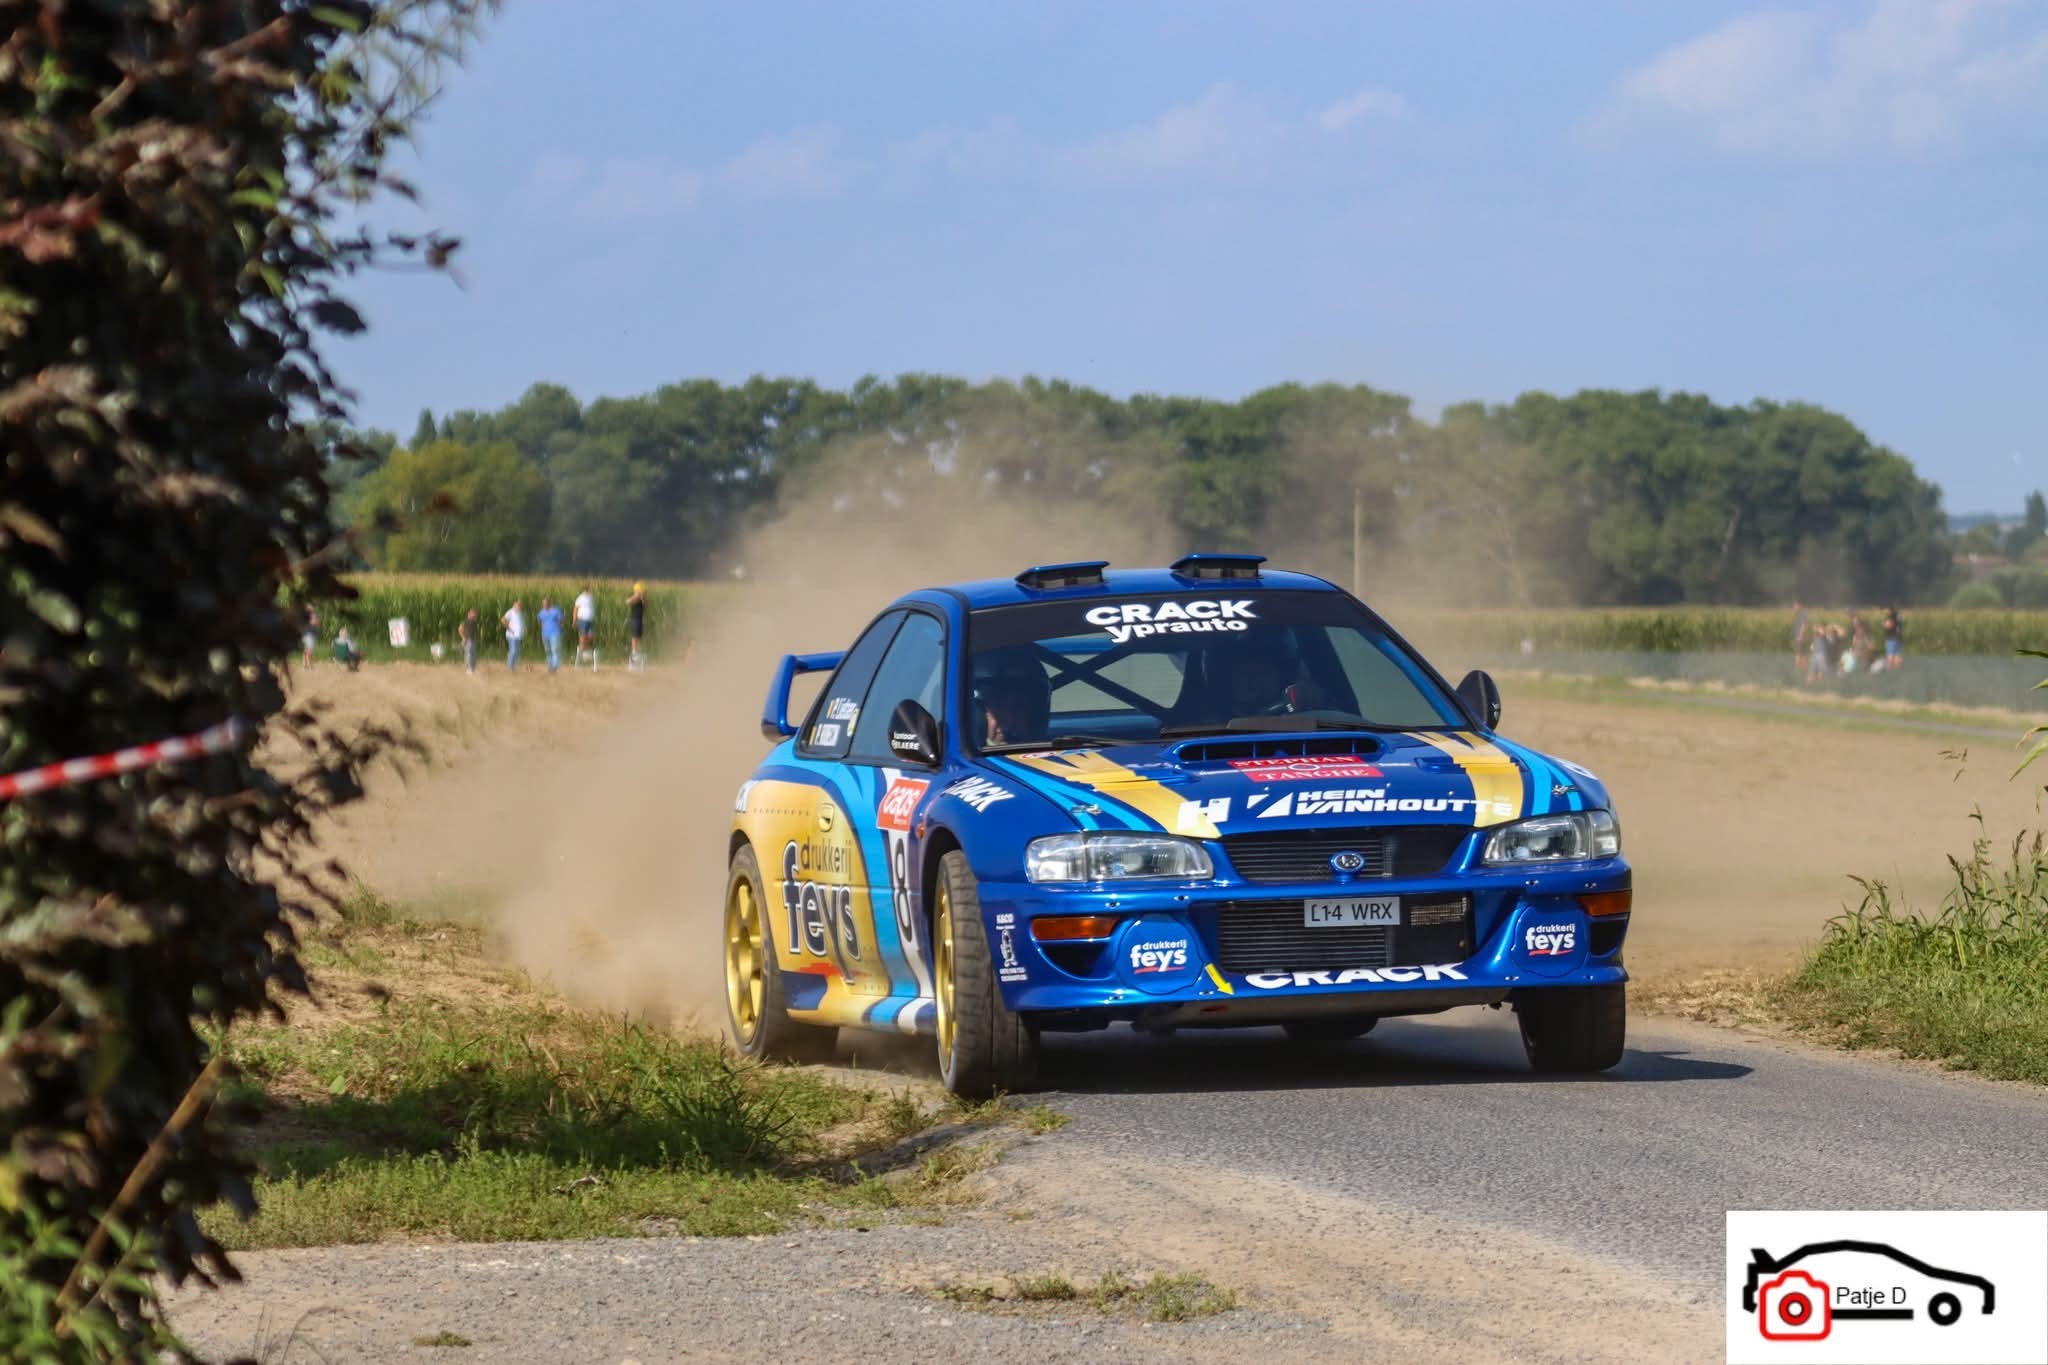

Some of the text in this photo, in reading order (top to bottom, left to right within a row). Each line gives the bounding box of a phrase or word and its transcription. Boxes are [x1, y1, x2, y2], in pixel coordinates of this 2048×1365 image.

[1085, 600, 1257, 625] CRACK
[1104, 619, 1248, 643] yprauto
[1258, 769, 1369, 780] TANGHE
[1298, 788, 1386, 801] HEIN
[1296, 798, 1513, 816] VANHOUTTE
[801, 836, 851, 882] drukkerij
[892, 838, 913, 943] 8
[783, 839, 863, 985] feys
[1351, 902, 1393, 920] WRX
[1536, 923, 1576, 933] drukkerij
[1142, 939, 1187, 950] drukkerij
[1525, 927, 1576, 956] feys
[1130, 945, 1187, 972] feys
[1245, 962, 1469, 989] CRACK
